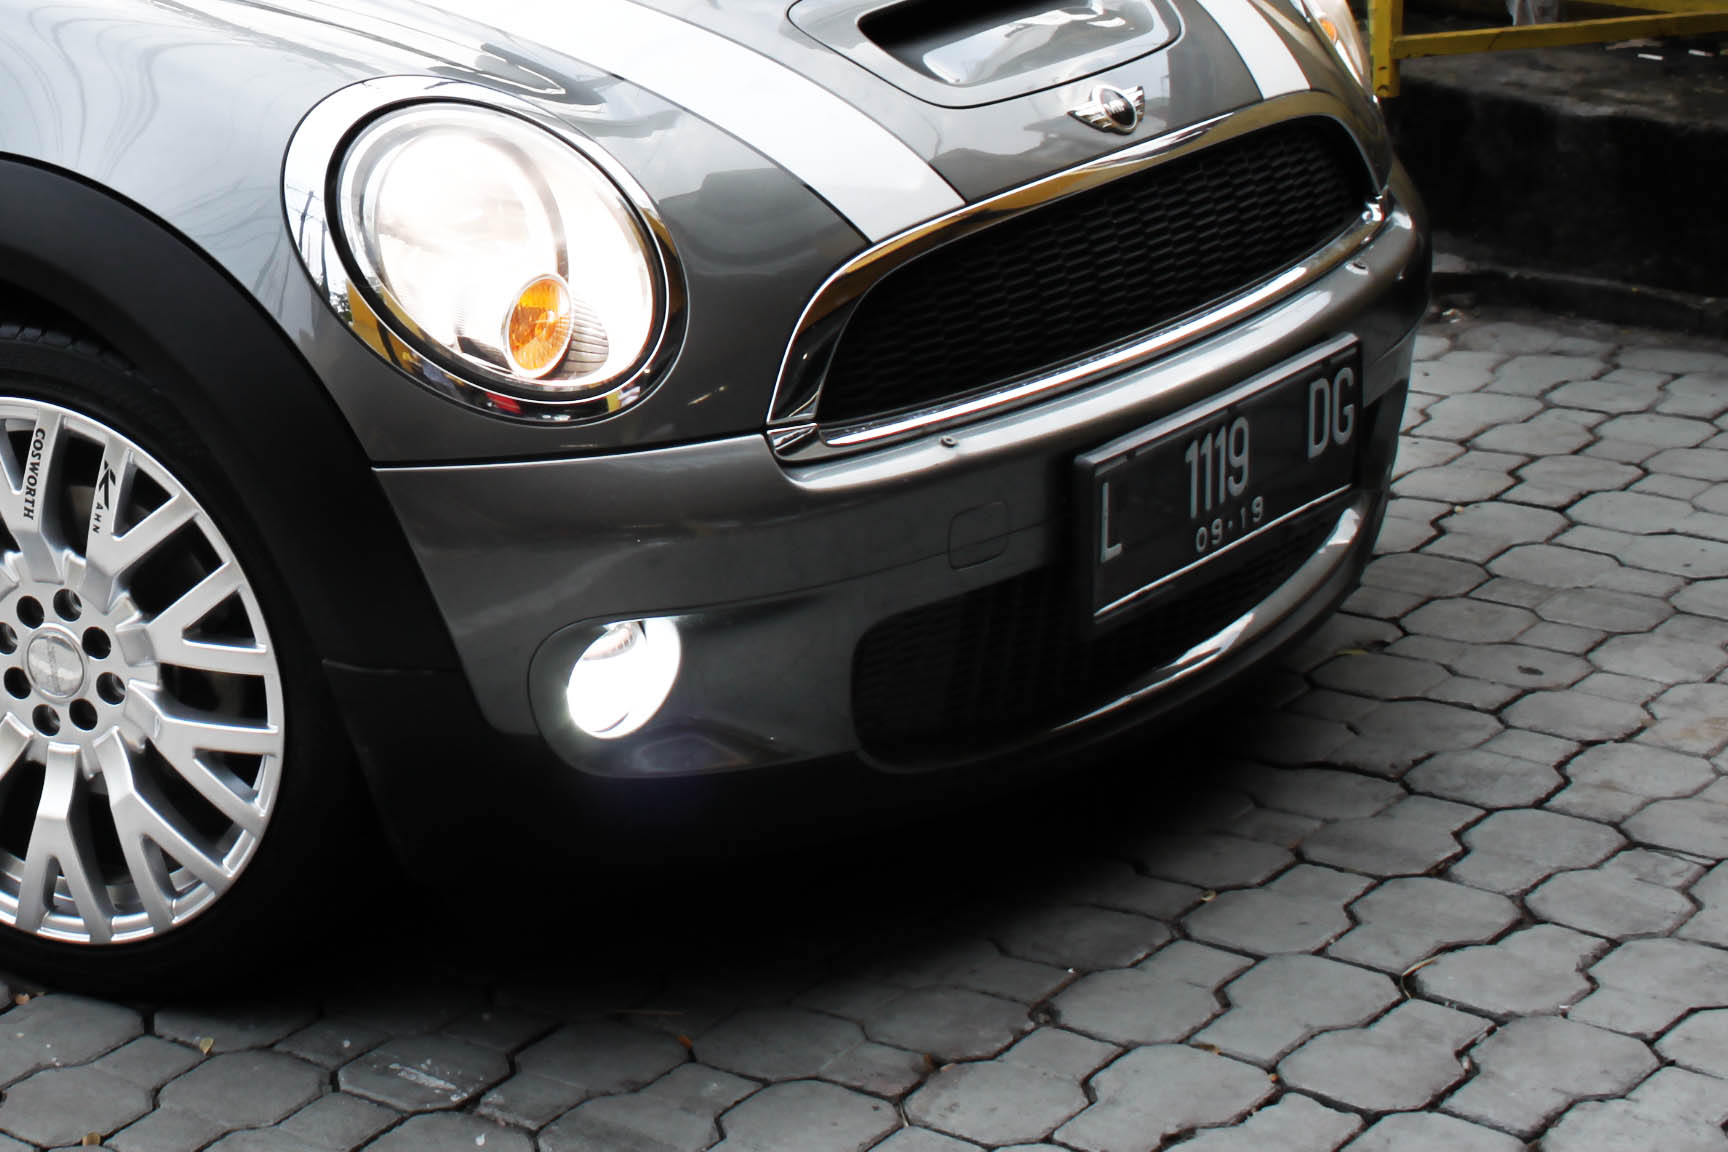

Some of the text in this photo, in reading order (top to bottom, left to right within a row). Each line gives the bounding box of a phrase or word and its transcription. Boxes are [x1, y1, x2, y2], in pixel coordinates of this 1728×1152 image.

[23, 428, 46, 521] COSWORTH
[1100, 366, 1355, 564] L 1119 DG
